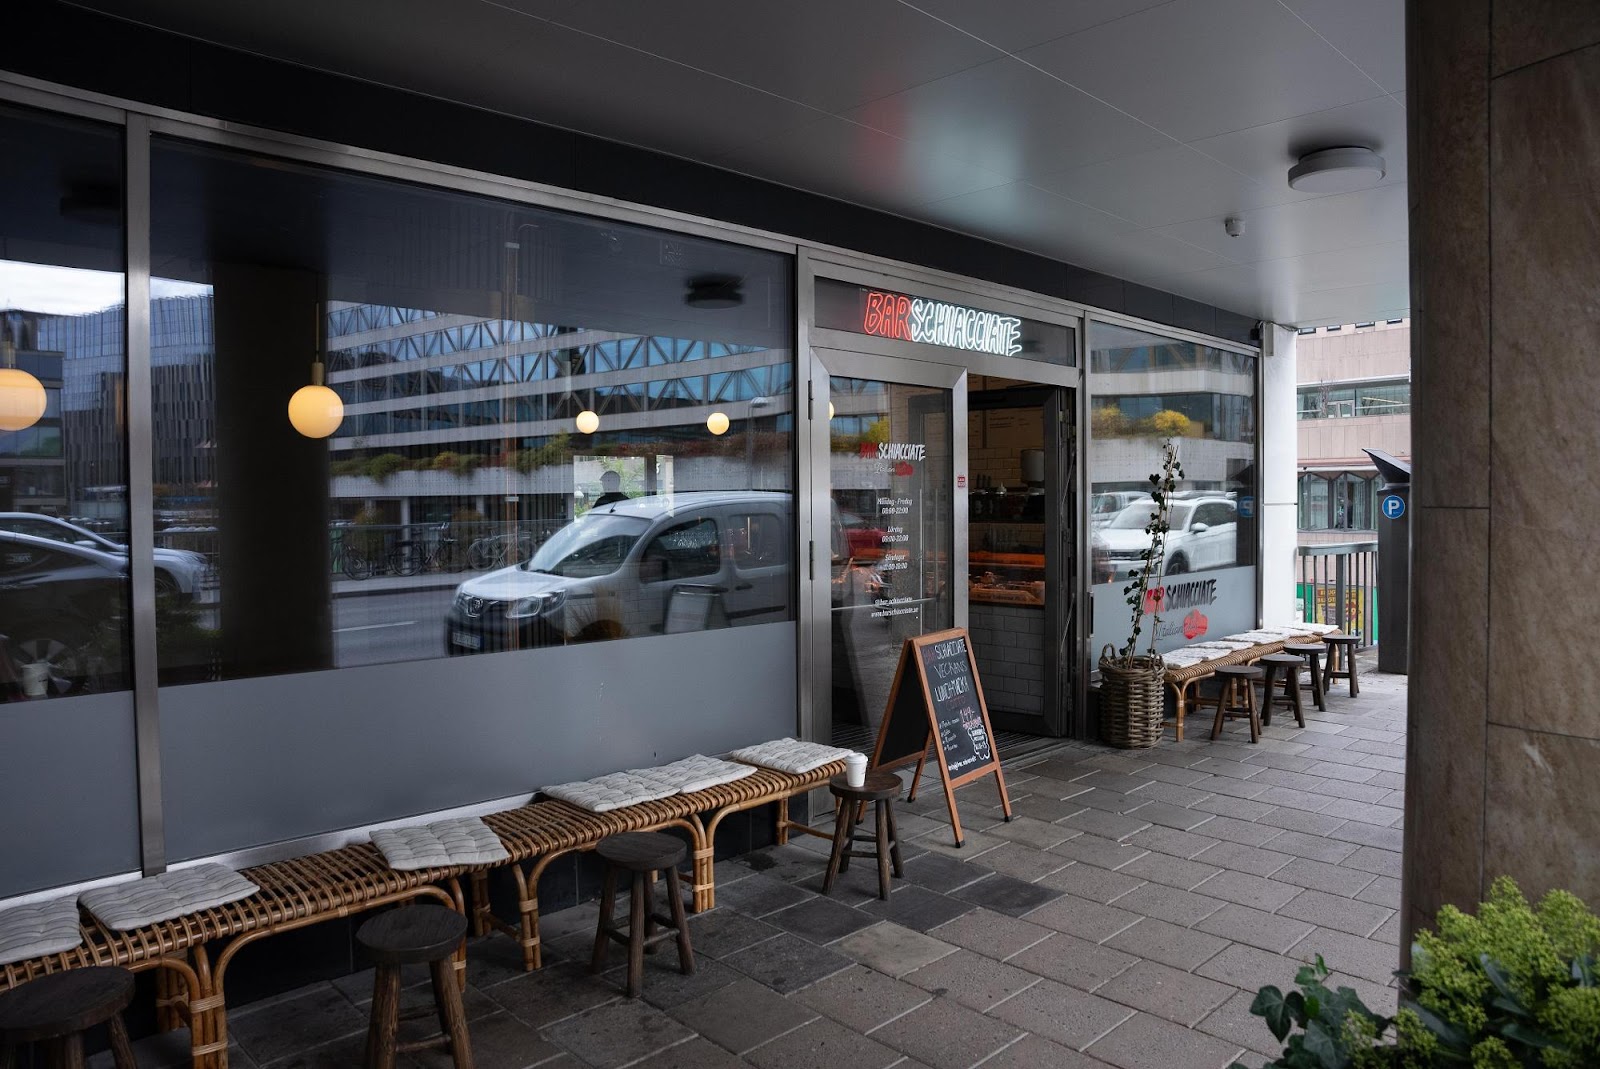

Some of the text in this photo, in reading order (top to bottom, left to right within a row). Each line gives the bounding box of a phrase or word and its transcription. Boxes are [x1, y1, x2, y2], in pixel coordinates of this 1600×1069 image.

[864, 292, 1022, 356] BAR SCHIACCIATE
[878, 442, 926, 461] SCHIACCIATE
[1388, 499, 1400, 515] P
[1166, 579, 1217, 611] SCHIACCIATE
